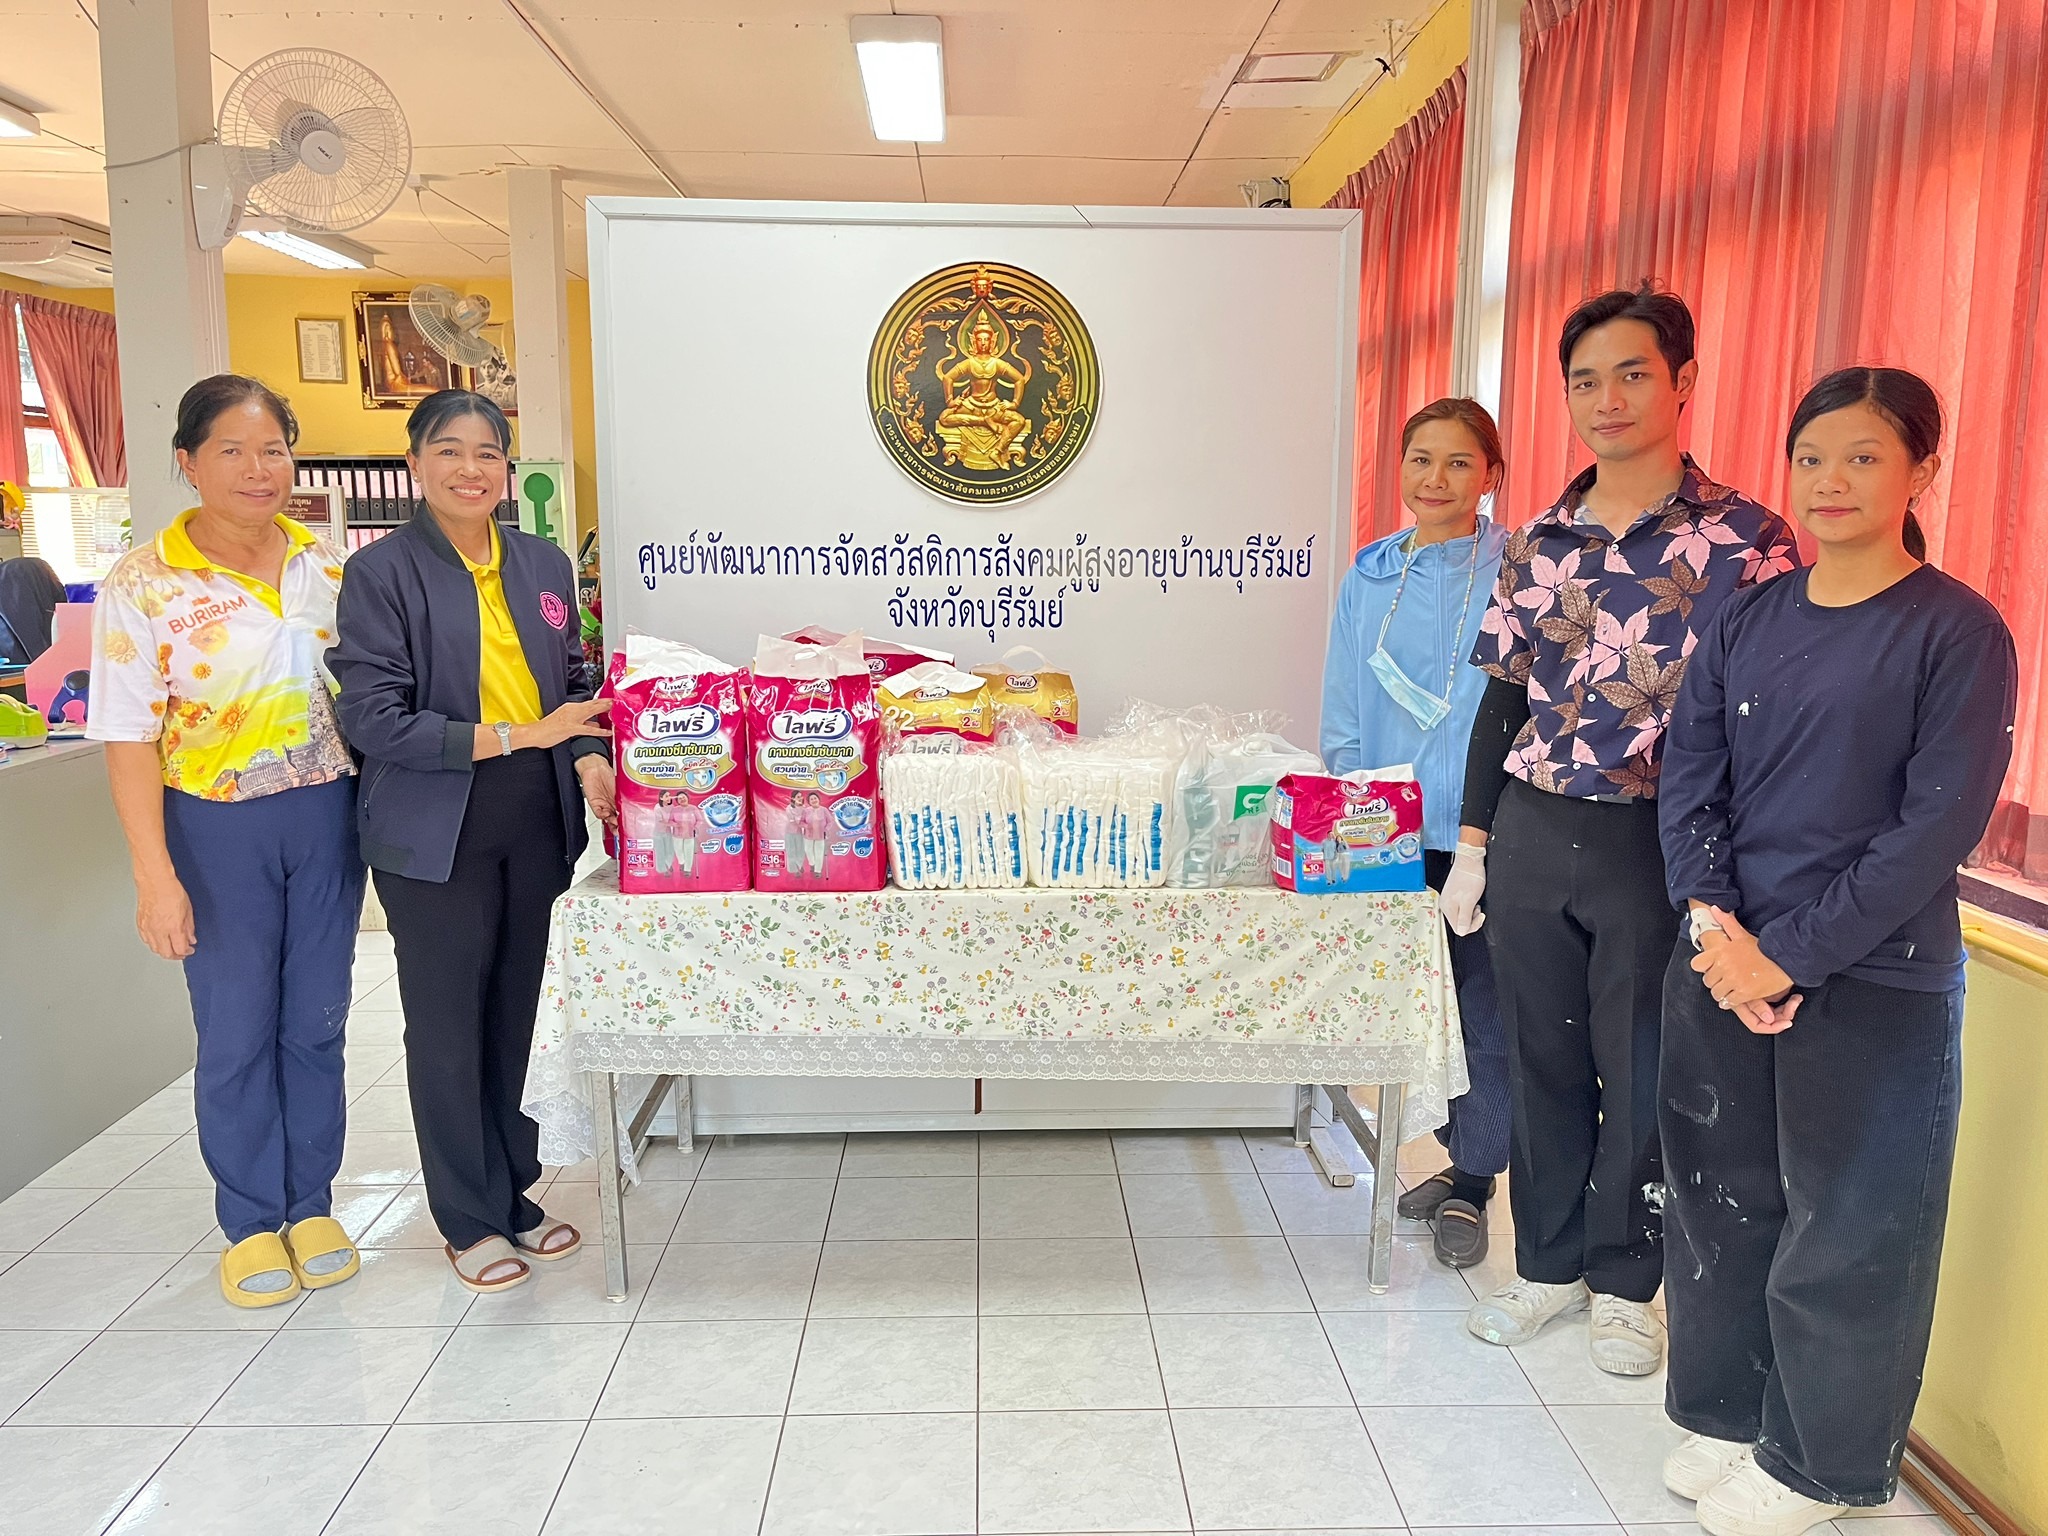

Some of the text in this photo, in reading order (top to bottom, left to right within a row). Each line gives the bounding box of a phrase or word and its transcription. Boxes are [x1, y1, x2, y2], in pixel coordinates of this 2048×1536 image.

[638, 529, 1316, 594] ศูนย์พัฒนาการจัดสวัสดิการสังคมผู้สูงอายุบ้านบุรีรัมย์
[168, 595, 248, 635] BURIRAM
[887, 585, 1067, 643] จังหวัดบุรีรัมย์
[1054, 706, 1062, 716] 2
[963, 716, 971, 728] 2
[633, 742, 723, 759] กางเกงซึมซับมาก
[768, 744, 853, 758] กางเกงซึมซับมาก
[640, 764, 674, 773] สวมง่าย
[773, 763, 807, 774] สวมง่าย
[628, 854, 649, 864] XL 16
[761, 854, 780, 864] XL 16
[1310, 863, 1320, 872] 10
